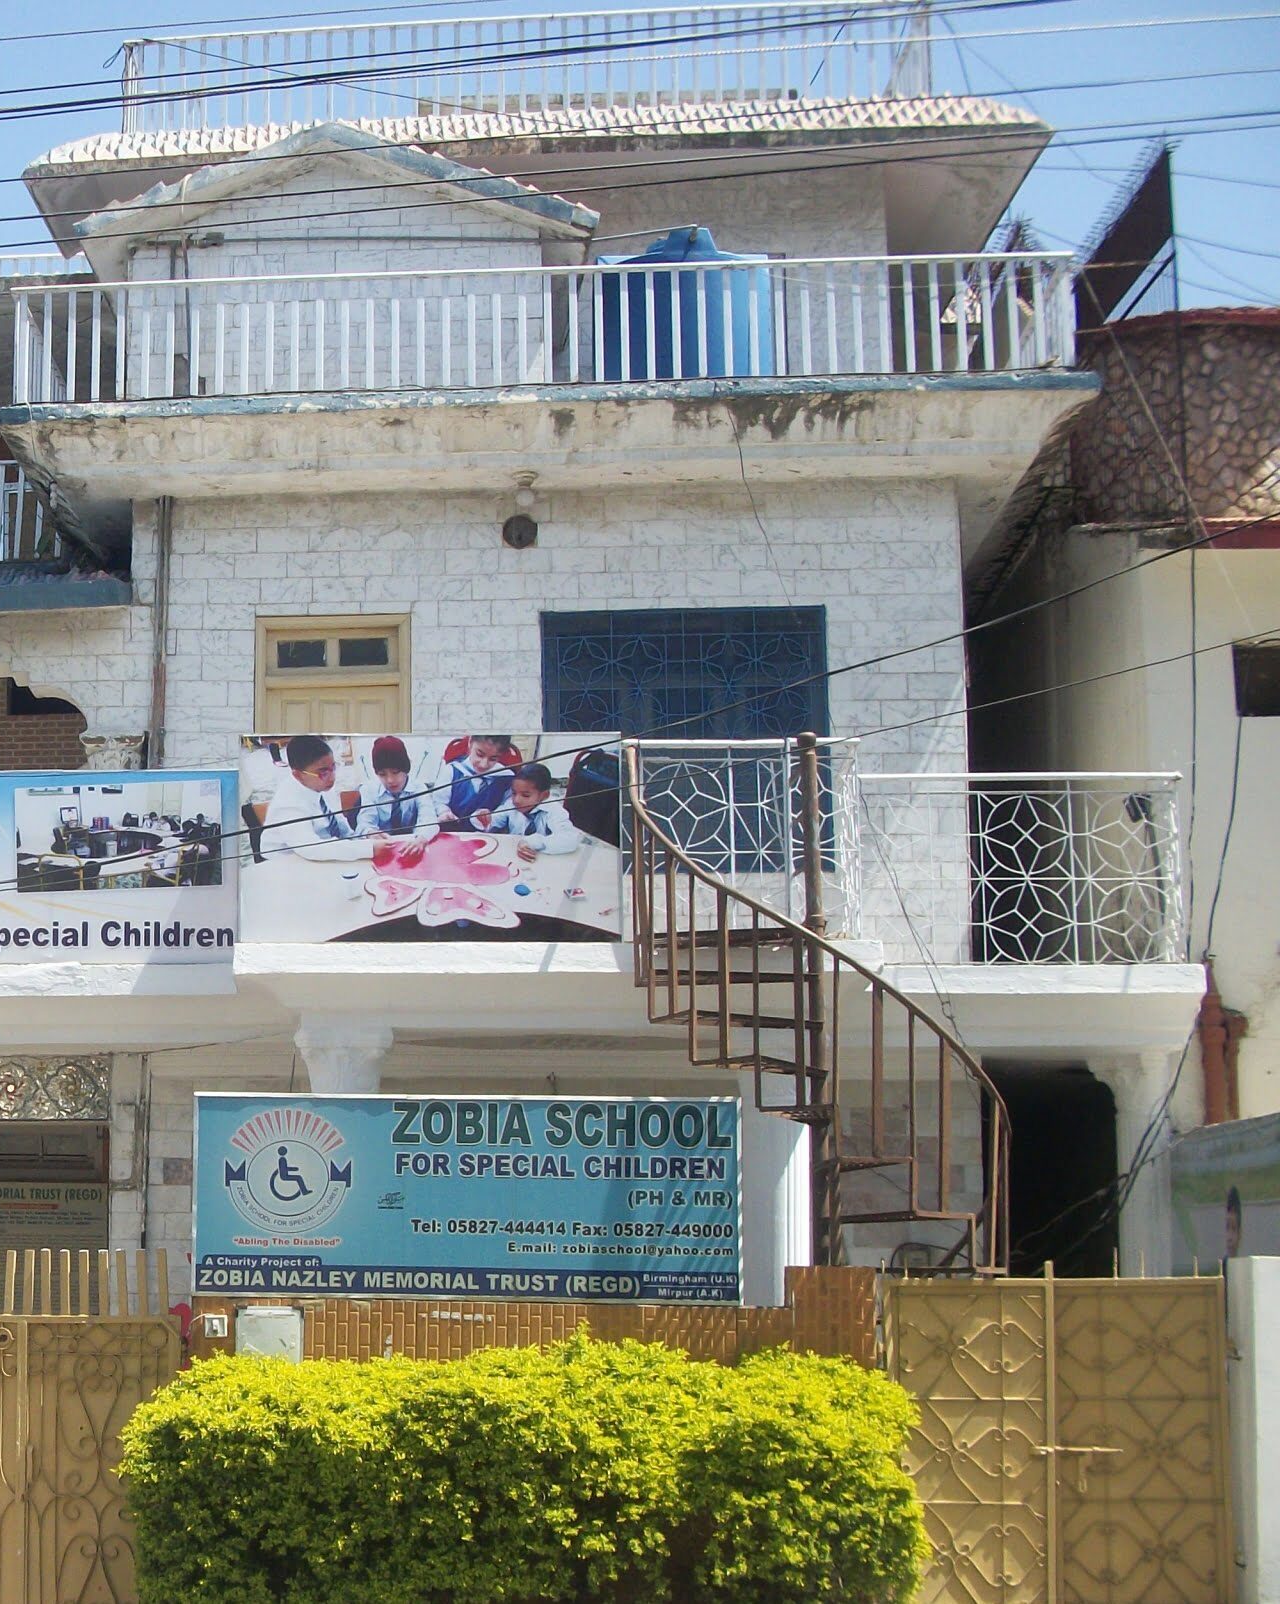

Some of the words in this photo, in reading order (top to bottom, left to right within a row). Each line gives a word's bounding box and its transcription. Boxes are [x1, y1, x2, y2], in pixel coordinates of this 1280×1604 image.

[100, 920, 234, 947] Children
[391, 1101, 532, 1146] ZOBIA
[545, 1101, 733, 1149] SCHOOL
[395, 1153, 451, 1177] FOR
[459, 1153, 575, 1178] SPECIAL
[583, 1155, 726, 1180] CHILDREN
[30, 1188, 61, 1200] TRUST
[64, 1188, 102, 1204] (REGD)
[628, 1190, 663, 1210] (PH
[671, 1190, 686, 1206] &
[694, 1190, 734, 1210] MR)
[411, 1218, 442, 1234] Tel:
[447, 1219, 566, 1236] 05827-444414
[572, 1222, 608, 1237] Fax:
[613, 1222, 734, 1239] 05827-449000
[272, 1237, 289, 1246] The
[508, 1241, 557, 1254] E.mail:
[562, 1242, 734, 1258] zobiaschool@yahoo.com
[205, 1256, 214, 1266] A
[216, 1256, 258, 1268] Charity
[261, 1257, 301, 1268] Project
[304, 1258, 320, 1267] of:
[199, 1269, 265, 1287] ZOBIA
[272, 1270, 357, 1288] NAZLEY
[363, 1271, 480, 1290] MEMORIAL
[486, 1273, 559, 1291] TRUST
[565, 1275, 641, 1297] (REGD)
[643, 1273, 708, 1286] Birmingham
[710, 1274, 737, 1286] (U.K)
[658, 1287, 693, 1299] Mirpur
[696, 1288, 724, 1299] (A.K)
